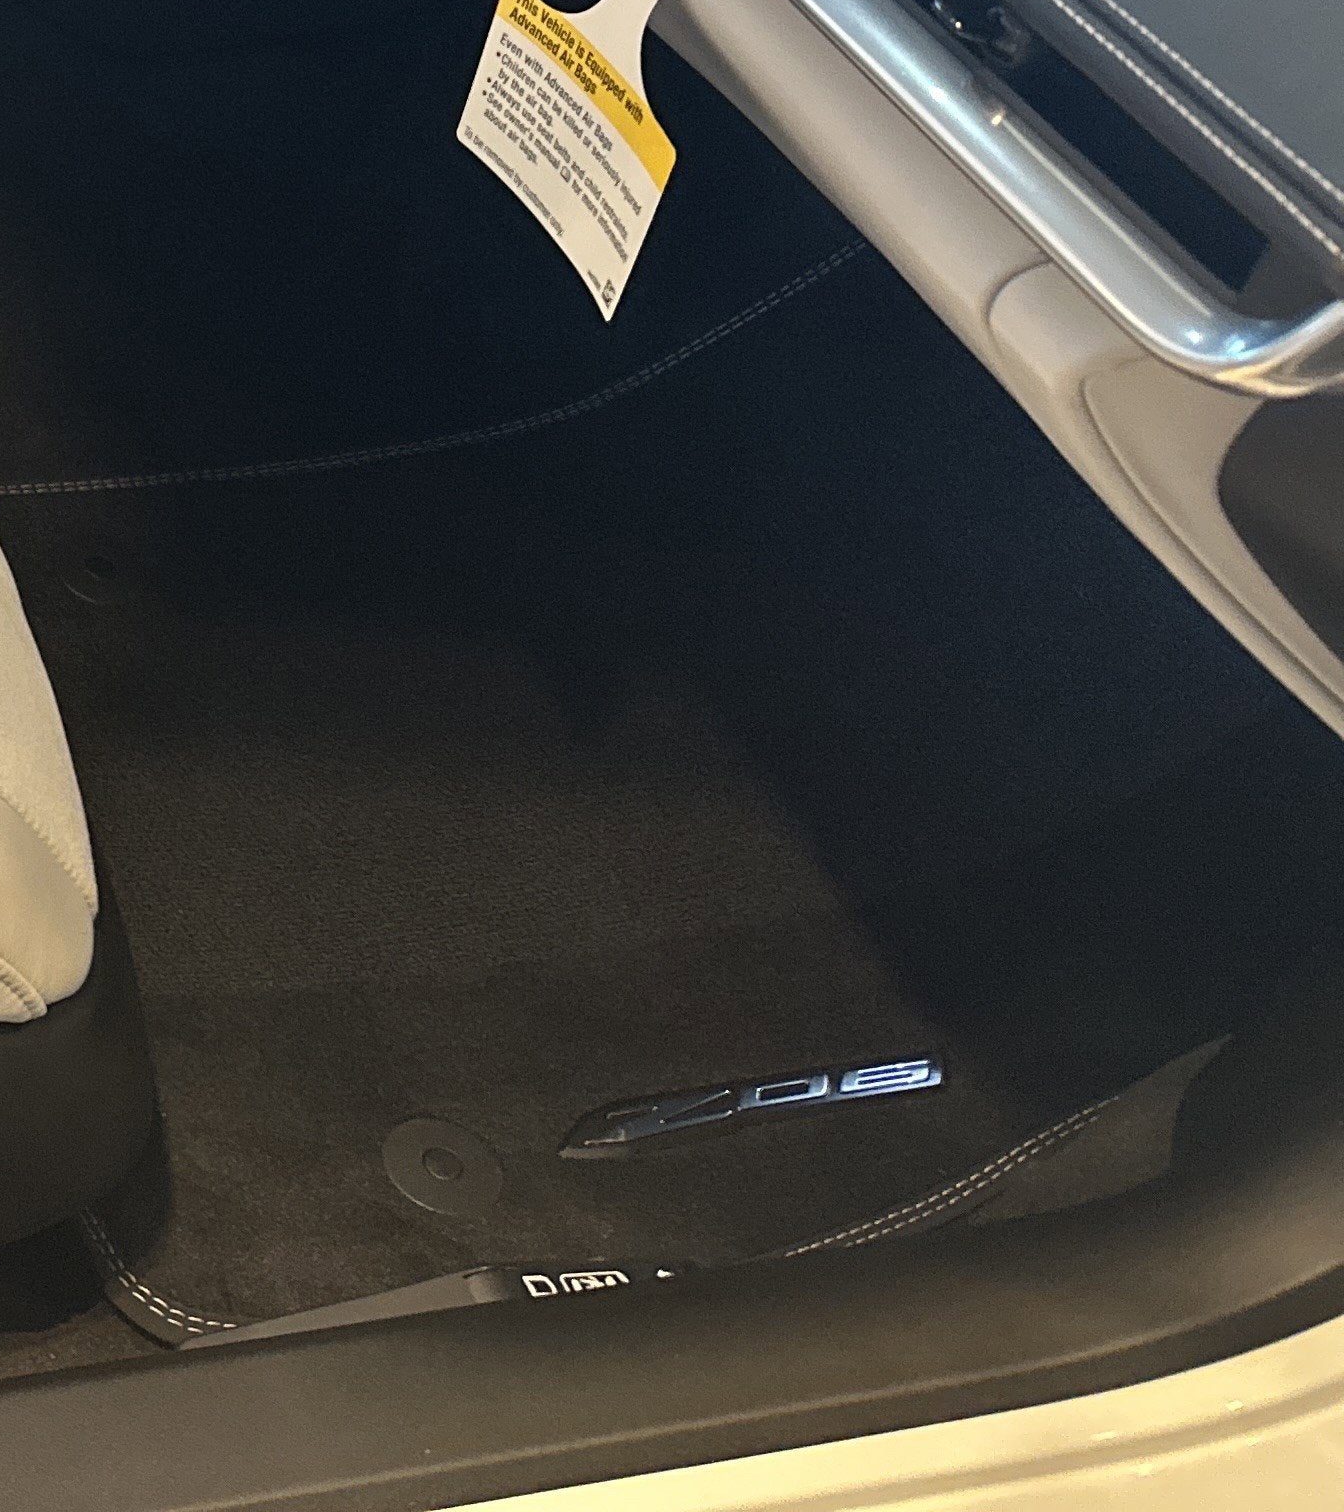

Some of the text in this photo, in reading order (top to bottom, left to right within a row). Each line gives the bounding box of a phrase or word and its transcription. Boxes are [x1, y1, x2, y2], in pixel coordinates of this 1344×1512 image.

[497, 68, 511, 85] by
[510, 78, 525, 97] the
[525, 94, 538, 109] air
[499, 32, 613, 152] Even with Advanced Air Bags
[508, 7, 597, 95] Advanced Air Bags
[540, 8, 576, 50] Vehicle
[574, 40, 586, 59] is
[584, 51, 627, 104] Equipped
[624, 96, 644, 125] with
[483, 109, 508, 133] about
[486, 92, 504, 113] See
[533, 138, 561, 170] manual
[570, 178, 583, 196] for
[491, 80, 521, 111] Always
[521, 107, 537, 126] use
[536, 122, 554, 145] seat
[552, 137, 571, 164] belts
[570, 160, 586, 180] and
[583, 176, 603, 201] child
[501, 53, 537, 89] Children
[536, 86, 552, 105] can
[551, 99, 563, 116] be
[562, 110, 584, 139] killed
[582, 135, 592, 148] or
[591, 146, 622, 187] seriously
